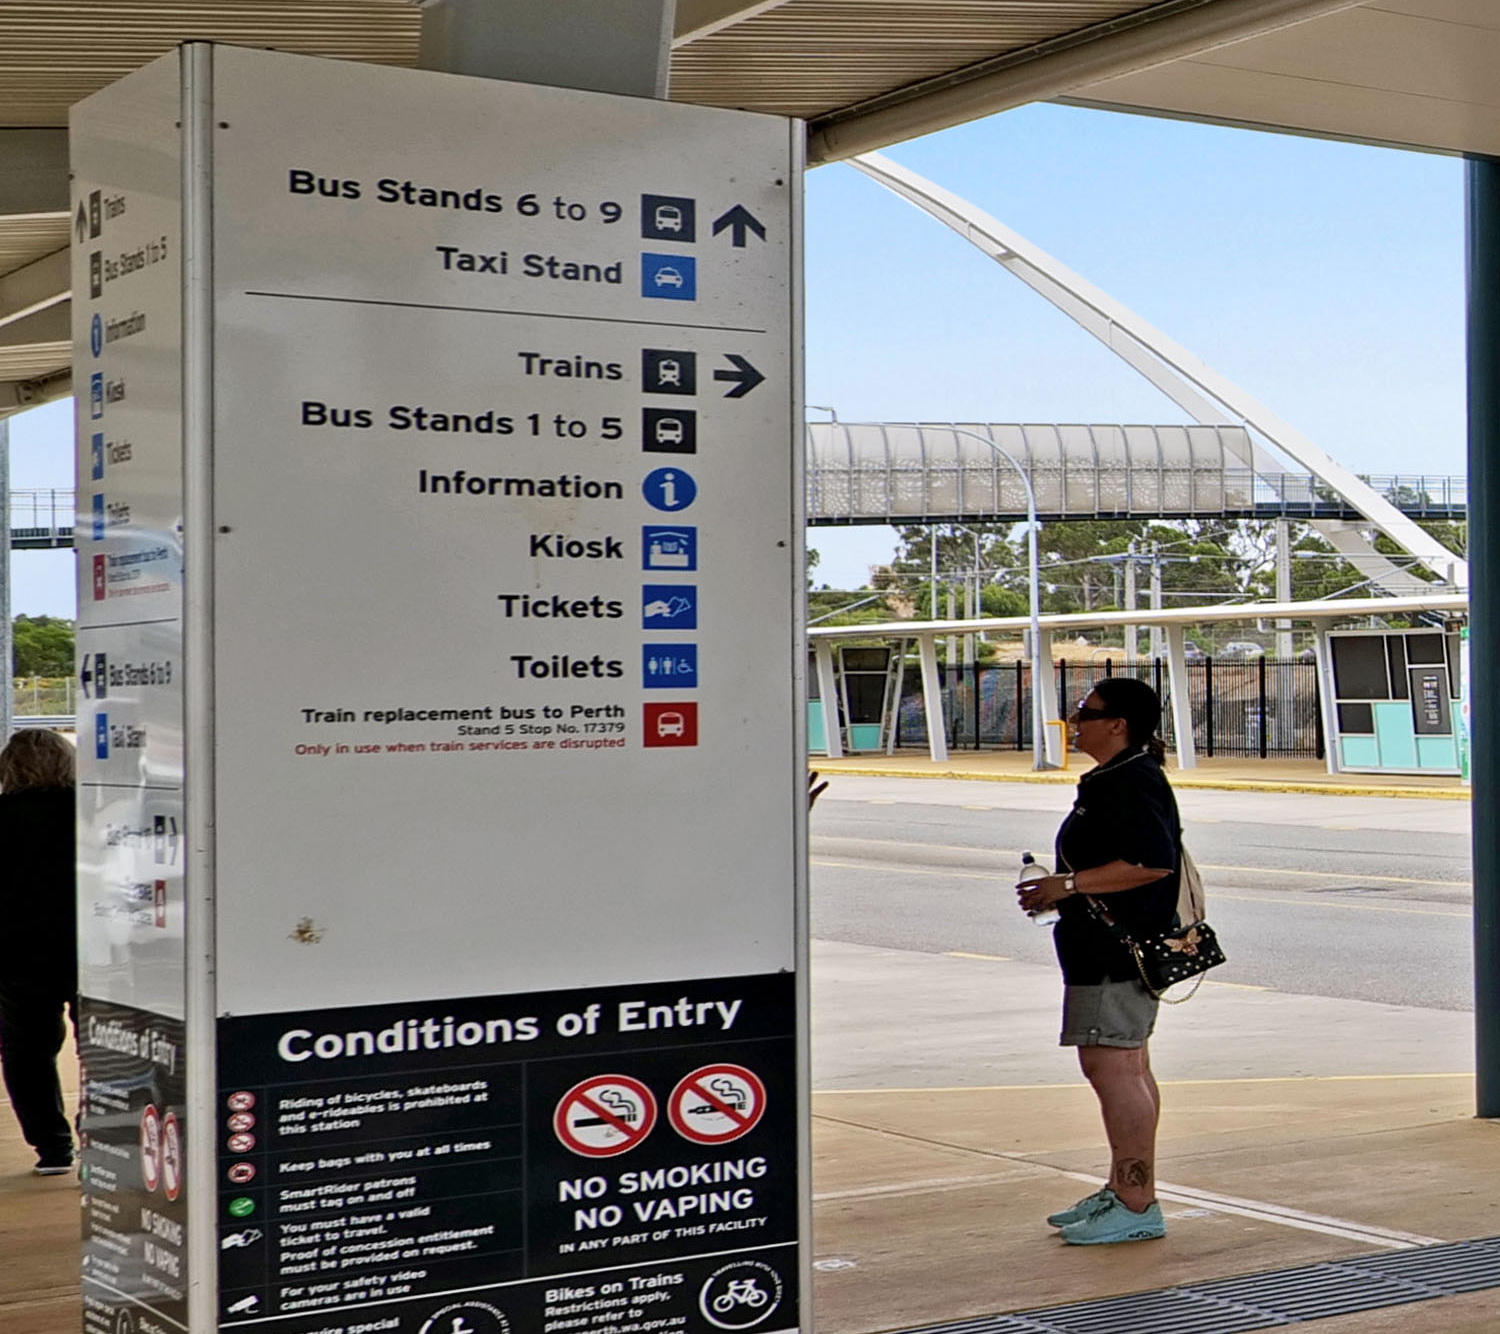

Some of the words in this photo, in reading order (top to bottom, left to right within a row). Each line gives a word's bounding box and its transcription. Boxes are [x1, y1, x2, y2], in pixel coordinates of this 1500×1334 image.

[289, 169, 361, 199] Bus
[377, 179, 502, 213] Stands
[517, 194, 539, 216] 6
[554, 196, 586, 221] to
[600, 202, 622, 224] 9
[436, 246, 508, 274] Taxi
[523, 254, 622, 284] Stand
[518, 352, 622, 380] Trains
[301, 401, 372, 428] Bus
[388, 406, 513, 435] Stands
[528, 414, 539, 436] 1
[554, 415, 587, 438] to
[601, 418, 623, 439] 5
[419, 469, 623, 499] Information
[530, 535, 623, 559] Kiosk
[498, 595, 623, 618] Tickets
[511, 655, 623, 679] Toilets
[302, 708, 355, 724] Train
[364, 706, 492, 724] replacement
[500, 706, 535, 720] bus
[543, 706, 562, 719] to
[571, 704, 624, 719] Perth
[457, 725, 499, 735] Stand
[504, 725, 514, 735] 5
[519, 724, 551, 735] Stop
[557, 723, 579, 734] No.
[584, 722, 625, 733] 17379
[295, 744, 330, 756] Only
[336, 743, 349, 754] in
[354, 743, 380, 754] use
[386, 741, 426, 753] when
[431, 740, 463, 752] train
[468, 739, 527, 751] services
[533, 739, 554, 749] are
[560, 737, 625, 750] disrupted
[277, 1015, 538, 1063] Conditions
[556, 1004, 601, 1038] of
[618, 997, 743, 1032] Entry
[89, 1016, 138, 1056] Conditions
[140, 1028, 150, 1059] of
[152, 1030, 176, 1076] Entry
[279, 1112, 305, 1123] and
[309, 1103, 384, 1119] e-rideables
[388, 1102, 400, 1112] is
[403, 1094, 470, 1111] prohibited
[474, 1093, 488, 1102] at
[280, 1097, 324, 1110] Riding
[327, 1094, 342, 1105] of
[407, 1080, 487, 1097] skateboards
[279, 1125, 307, 1135] this
[311, 1119, 360, 1132] station
[279, 1162, 315, 1173] Keep
[318, 1158, 351, 1170] bags
[355, 1152, 384, 1164] with
[388, 1150, 412, 1162] you
[416, 1147, 431, 1157] at
[435, 1145, 450, 1155] all
[454, 1141, 491, 1152] times
[280, 1183, 361, 1200] SmartRider
[364, 1176, 416, 1195] patrons
[559, 1176, 607, 1202] NO
[618, 1157, 767, 1194] SMOKING
[280, 1200, 316, 1213] must
[320, 1197, 344, 1208] tag
[347, 1195, 364, 1204] on
[368, 1191, 392, 1202] and
[396, 1188, 416, 1199] off
[575, 1205, 622, 1231] NO
[633, 1189, 753, 1222] VAPING
[280, 1224, 308, 1234] You
[311, 1218, 347, 1230] must
[350, 1214, 382, 1226] have
[386, 1211, 395, 1220] a
[399, 1206, 430, 1218] valid
[280, 1234, 321, 1247] ticket
[325, 1230, 340, 1241] to
[280, 1250, 319, 1262] Proof
[322, 1246, 337, 1257] of
[340, 1236, 414, 1254] concession
[418, 1226, 494, 1244] entitlement
[559, 1244, 575, 1253] IN
[578, 1239, 609, 1251] ANY
[612, 1233, 649, 1247] PART
[652, 1230, 671, 1241] OF
[675, 1225, 705, 1238] THIS
[709, 1217, 768, 1234] FACILITY
[280, 1262, 316, 1275] must
[320, 1258, 338, 1269] be
[341, 1250, 400, 1268] provided
[403, 1247, 419, 1258] on
[280, 1296, 340, 1310] cameras
[344, 1291, 366, 1301] are
[370, 1288, 383, 1298] in
[387, 1285, 411, 1296] use
[281, 1287, 304, 1298] For
[308, 1283, 340, 1295] your
[344, 1275, 387, 1289] safety
[391, 1270, 427, 1281] video
[545, 1285, 595, 1303] Bikes
[601, 1282, 623, 1295] on
[628, 1273, 684, 1289] Trains
[545, 1298, 628, 1317] Restrictions
[545, 1317, 587, 1333] please
[592, 1312, 625, 1323] refer
[628, 1309, 643, 1318] to
[347, 1318, 400, 1334] special
